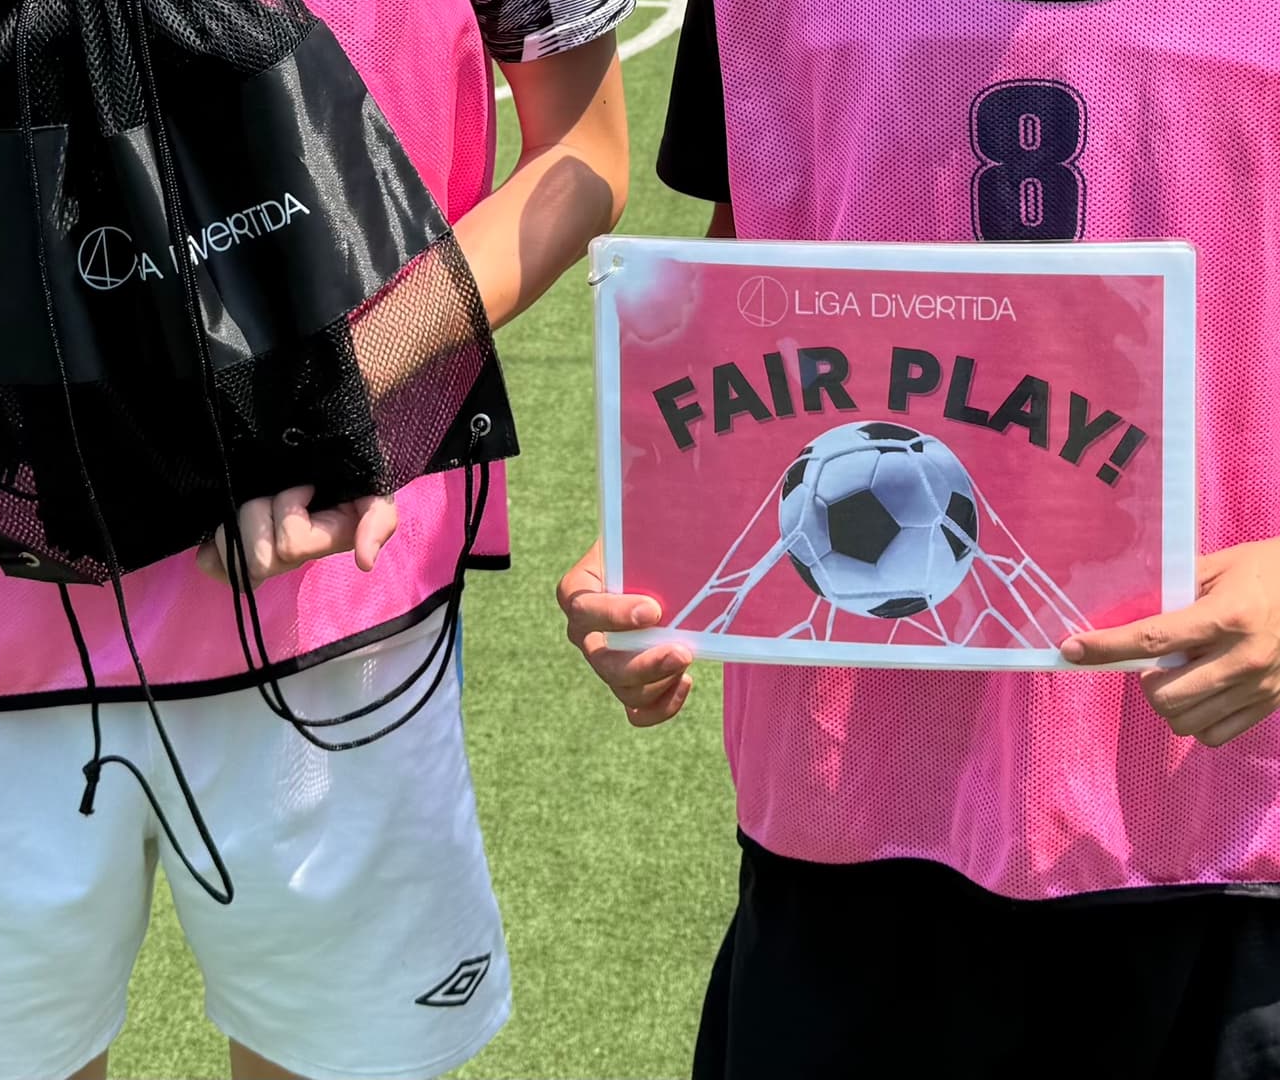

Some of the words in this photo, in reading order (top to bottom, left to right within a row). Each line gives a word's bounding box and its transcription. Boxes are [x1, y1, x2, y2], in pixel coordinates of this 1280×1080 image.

[969, 77, 1088, 241] 8
[653, 346, 860, 452] FAIR
[887, 346, 1148, 488] PLAY!
